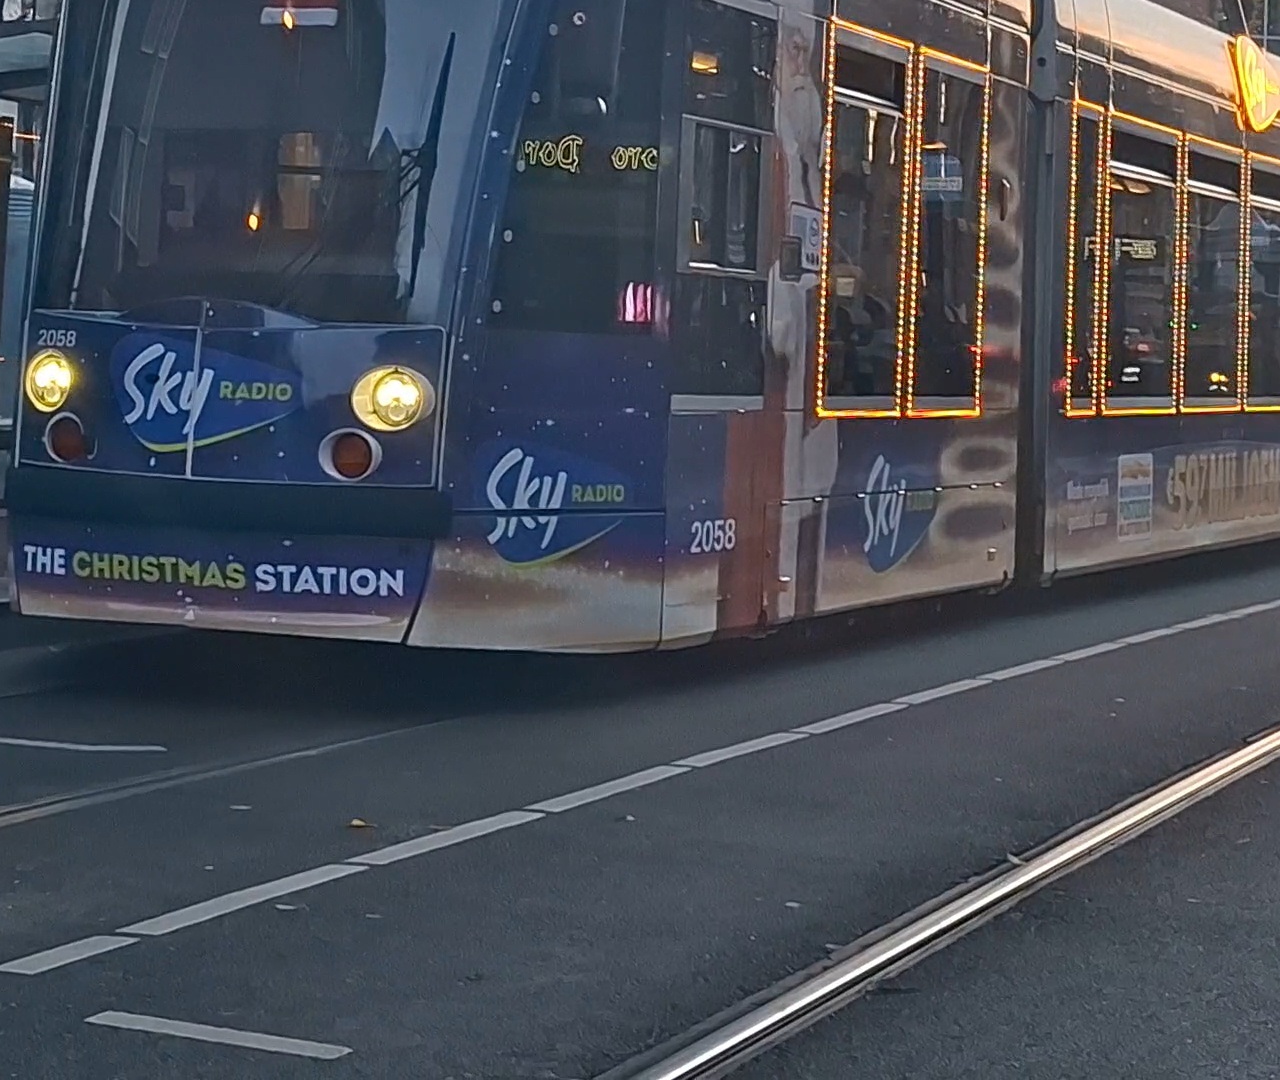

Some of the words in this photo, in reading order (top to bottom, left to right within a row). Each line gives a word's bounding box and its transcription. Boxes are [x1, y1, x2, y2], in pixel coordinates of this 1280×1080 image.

[37, 329, 77, 348] 2058
[123, 343, 215, 435] Sky
[219, 381, 293, 401] RADIO
[486, 447, 568, 550] Sky
[572, 484, 625, 503] RADIO
[863, 454, 907, 558] Sky
[23, 545, 66, 575] THE
[72, 551, 247, 590] CHRISTMAS
[254, 563, 404, 597] STATION
[690, 518, 736, 554] 2058
